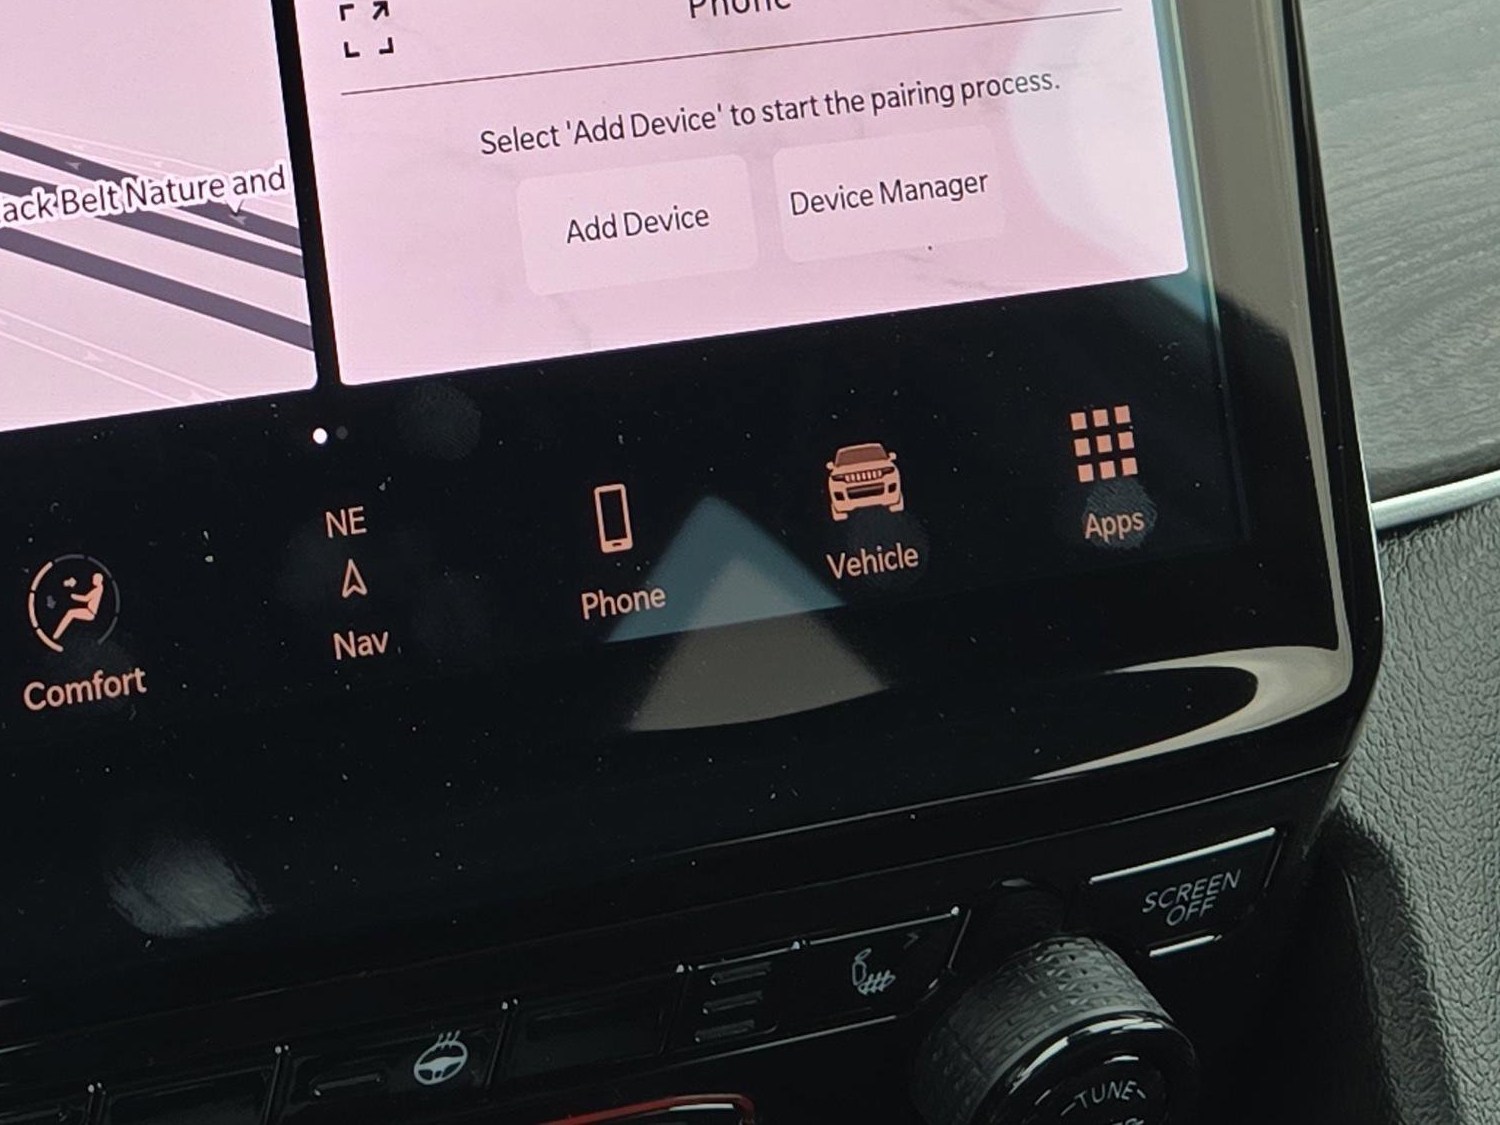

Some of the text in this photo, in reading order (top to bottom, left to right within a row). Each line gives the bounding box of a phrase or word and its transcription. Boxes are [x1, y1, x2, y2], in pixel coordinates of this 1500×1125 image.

[480, 71, 1060, 156] Select 'Add Device' to start the pairing process.
[60, 185, 118, 217] Belt
[124, 178, 225, 208] Nature
[232, 165, 286, 196] and
[790, 172, 988, 216] Device Manager
[566, 204, 711, 244] Add Device
[325, 506, 368, 538] NE
[1084, 509, 1145, 541] Apps
[826, 543, 920, 580] Vehicle
[581, 586, 667, 621] Phone
[333, 630, 389, 661] Nav
[22, 667, 148, 711] Comfort
[1142, 869, 1242, 914] SCREEN
[1166, 896, 1219, 927] OFF
[1074, 1080, 1137, 1109] TUNE
